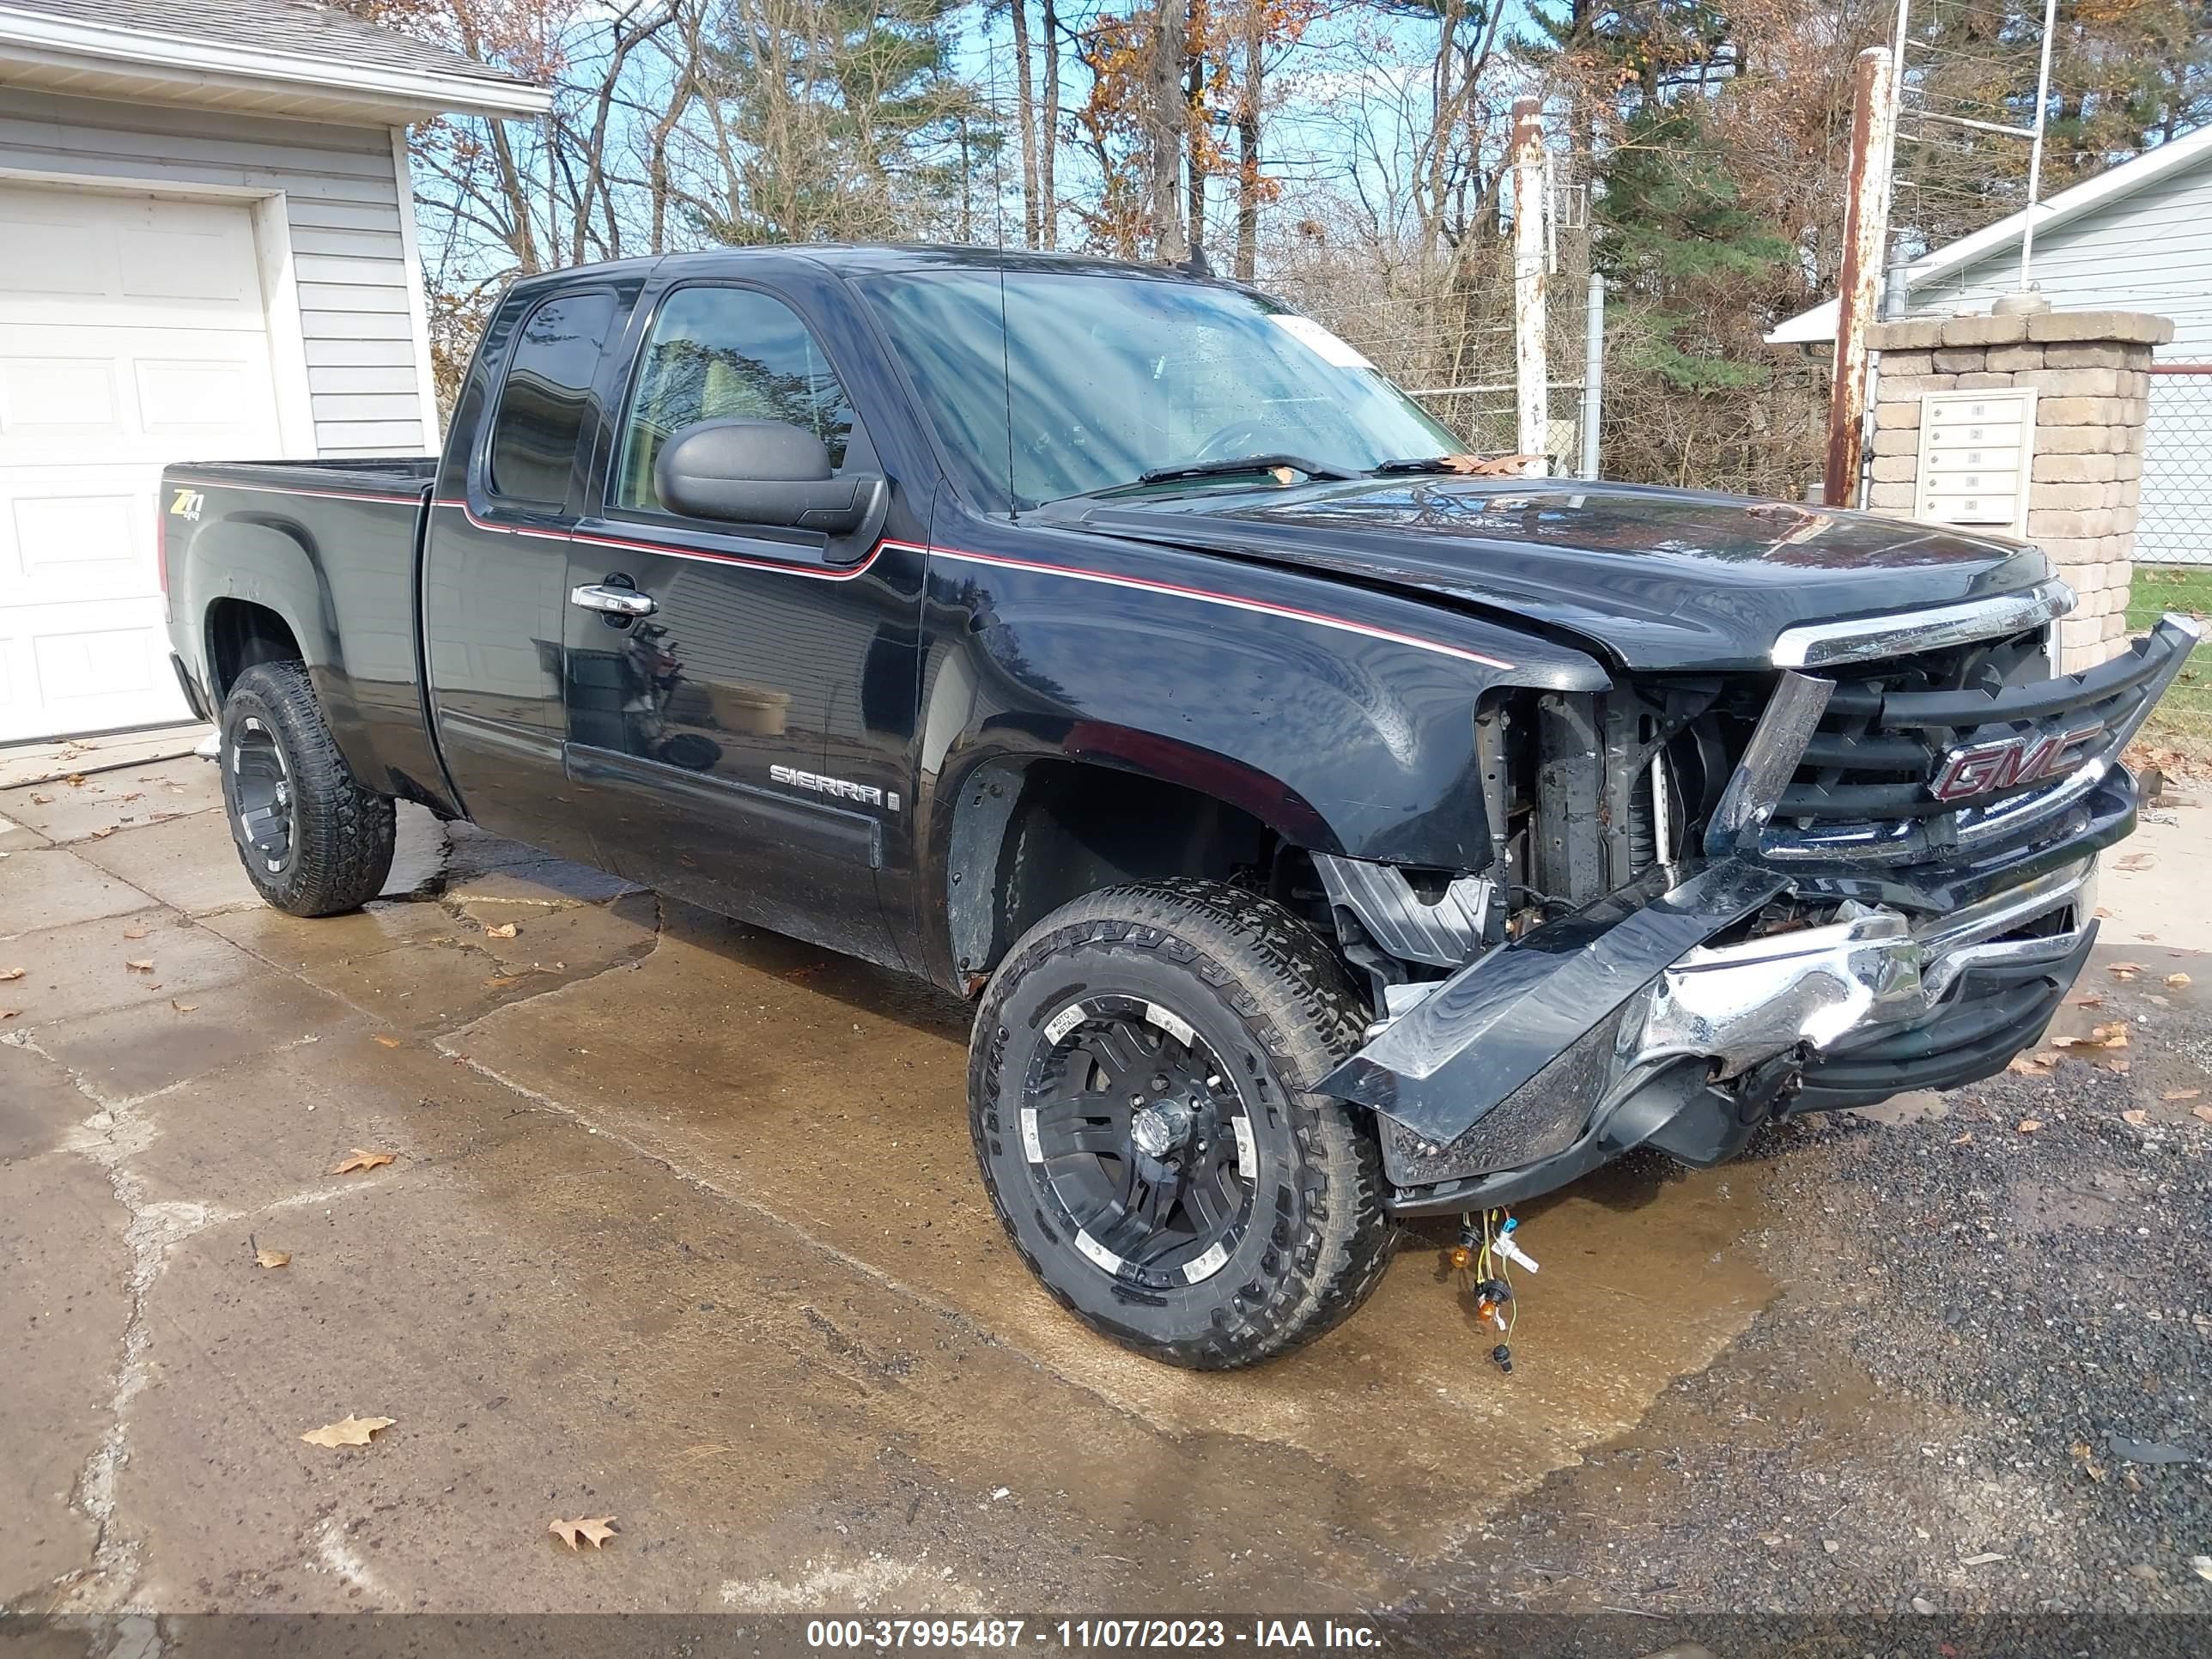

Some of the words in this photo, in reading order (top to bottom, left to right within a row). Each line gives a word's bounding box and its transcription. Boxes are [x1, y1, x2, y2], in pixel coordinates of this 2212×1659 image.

[170, 489, 204, 514] Z71
[1929, 720, 2104, 802] GMC
[769, 764, 881, 806] SIERRA
[1052, 1012, 1070, 1029] MOTO
[1056, 1018, 1077, 1037] METAL
